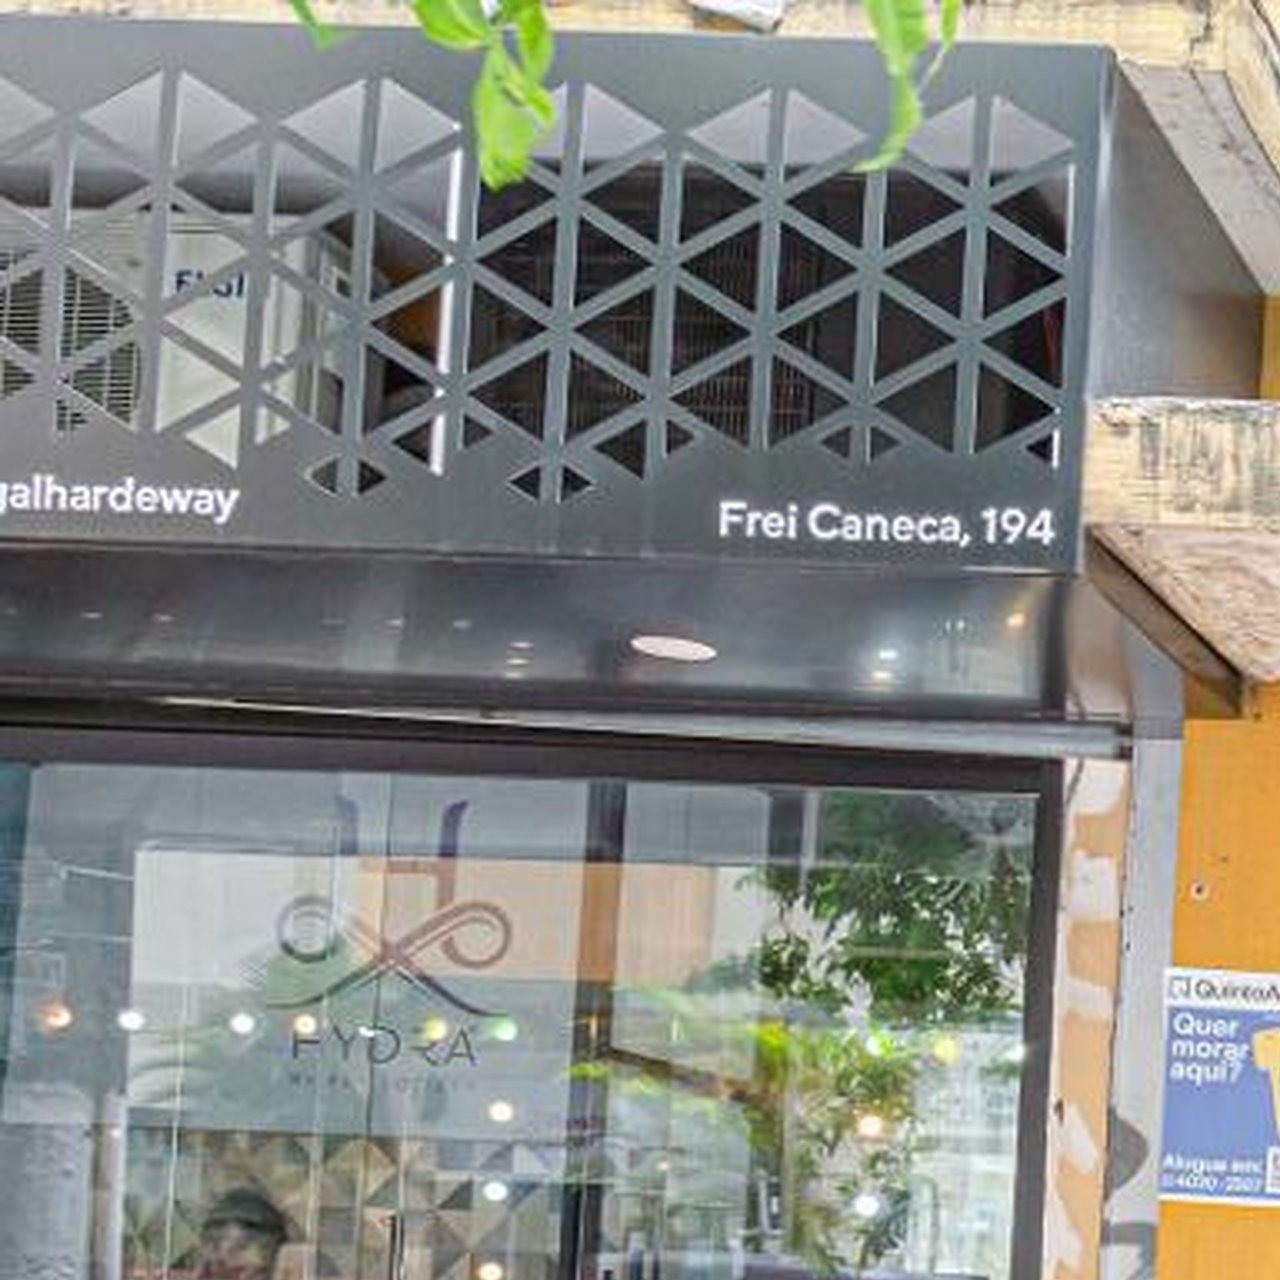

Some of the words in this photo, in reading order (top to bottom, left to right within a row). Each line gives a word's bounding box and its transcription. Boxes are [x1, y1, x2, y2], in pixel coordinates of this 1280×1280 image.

[718, 501, 798, 539] Frei
[808, 504, 972, 547] Caneca,
[980, 506, 1056, 545] 194
[1173, 1012, 1241, 1038] Quer
[1172, 1039, 1250, 1062] morar
[1170, 1060, 1243, 1086] aqui?
